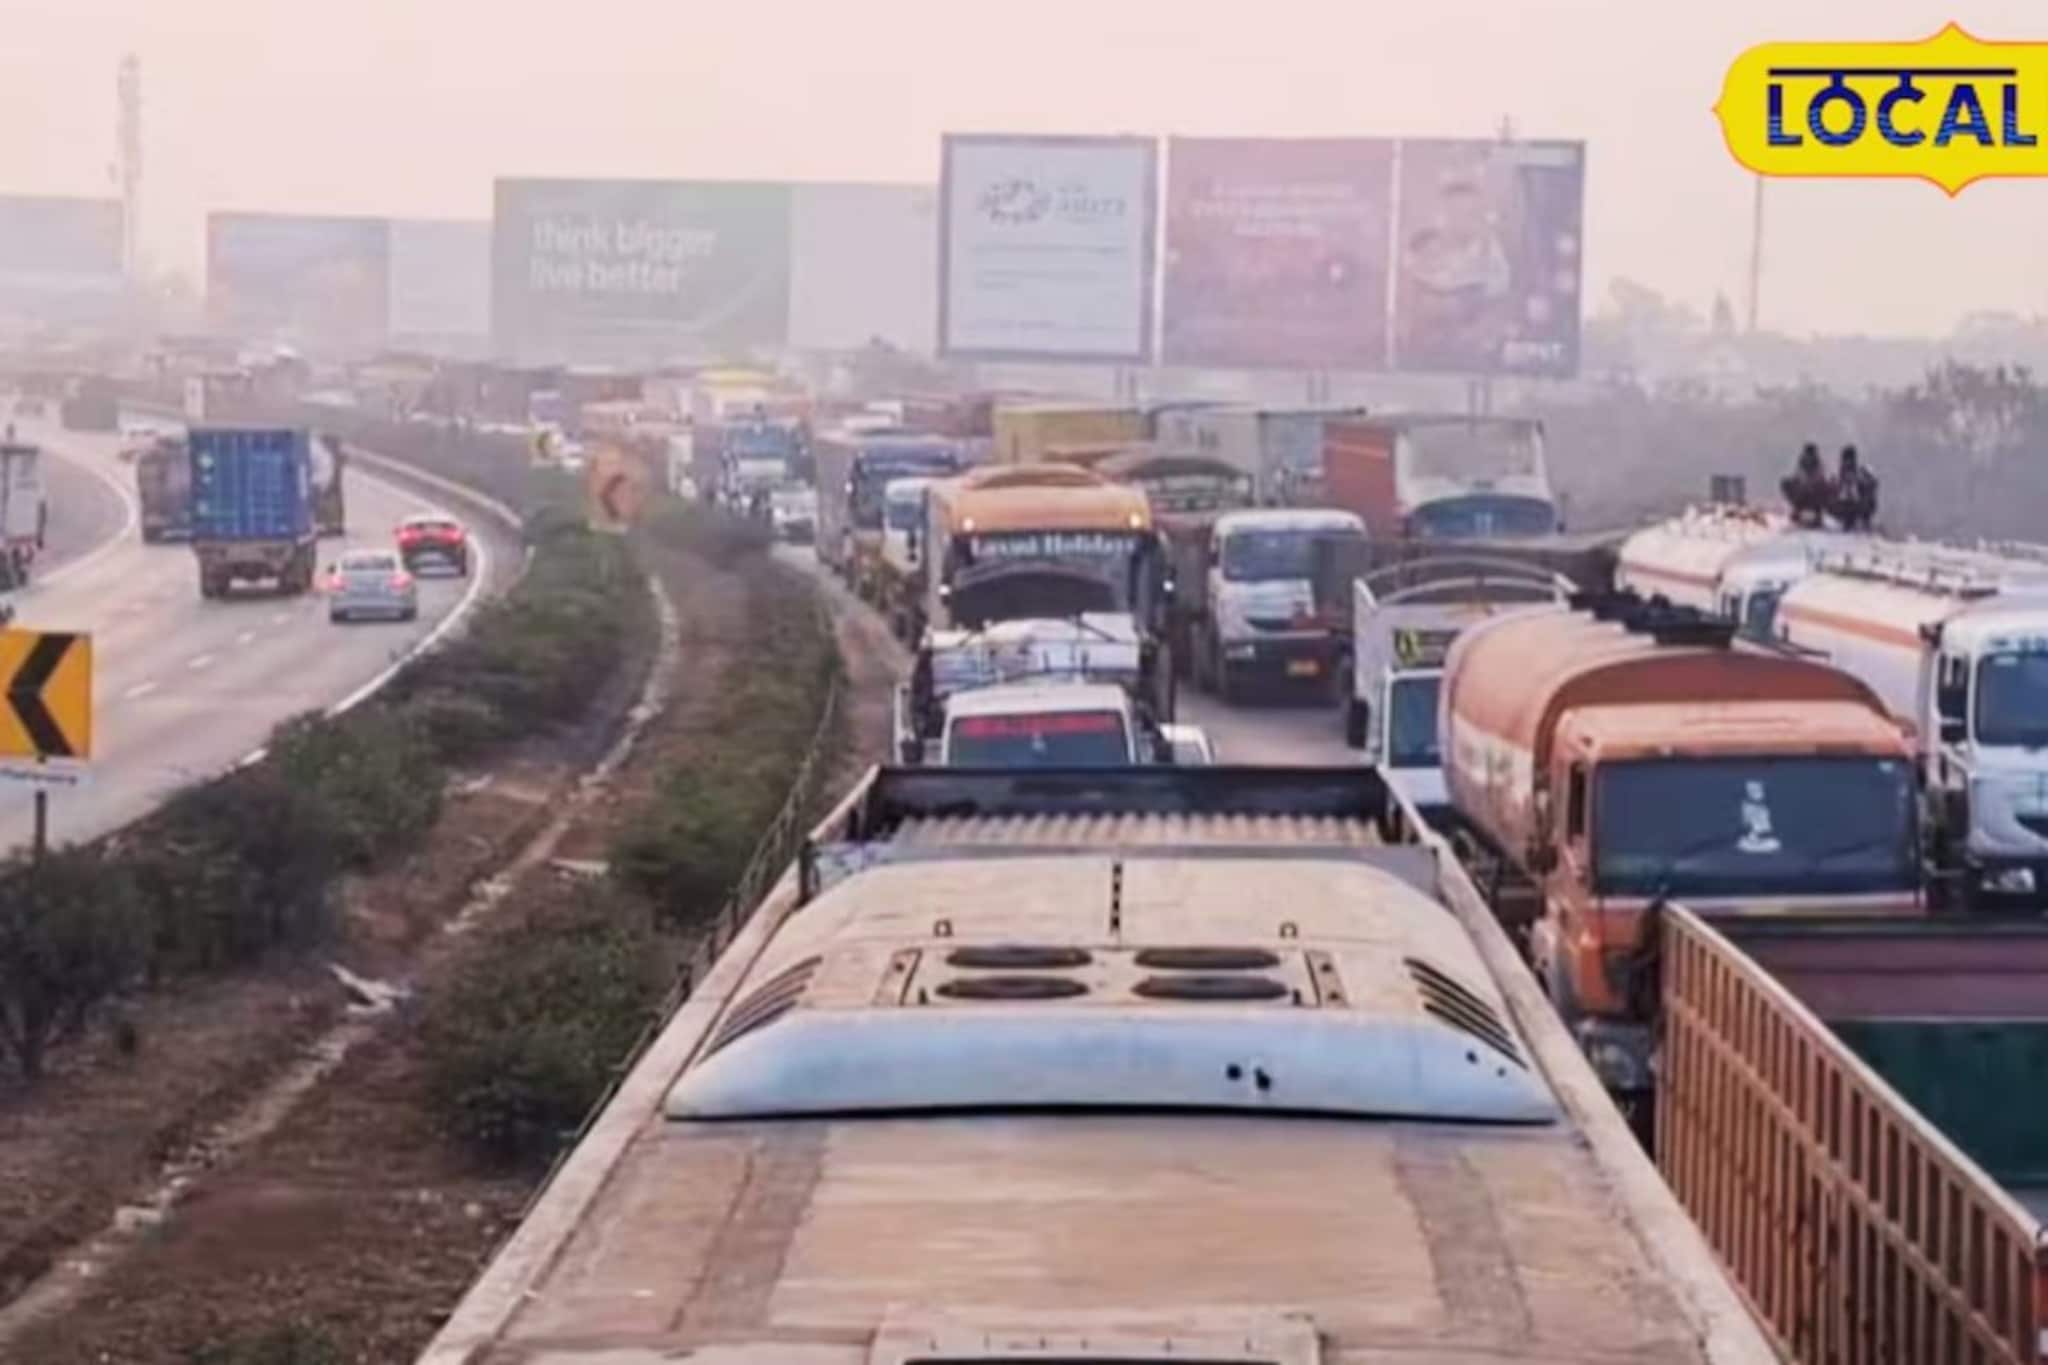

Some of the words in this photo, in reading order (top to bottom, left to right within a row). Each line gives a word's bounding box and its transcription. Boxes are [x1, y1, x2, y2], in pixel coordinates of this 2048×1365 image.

[533, 215, 610, 253] think
[616, 219, 719, 261] bigger
[529, 256, 583, 290] live
[587, 259, 682, 292] better
